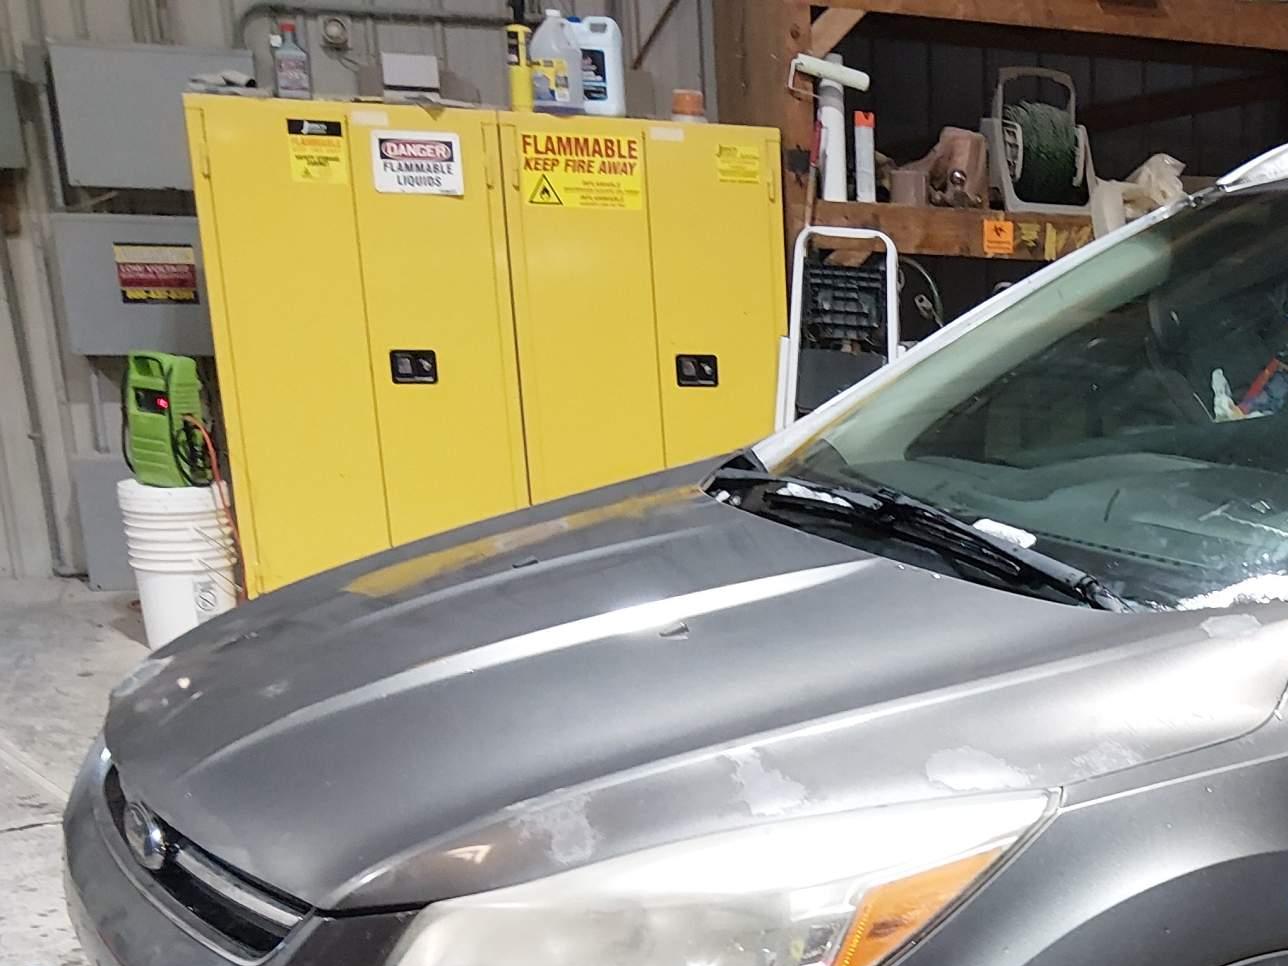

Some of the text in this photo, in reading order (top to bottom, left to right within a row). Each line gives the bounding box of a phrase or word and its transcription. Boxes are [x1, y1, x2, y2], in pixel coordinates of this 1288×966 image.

[385, 143, 447, 159] DANGER
[521, 134, 638, 159] FLAMMABLE
[383, 161, 454, 175] FLAMMABLE
[523, 156, 637, 176] KEEP FIRE AWAY
[396, 175, 442, 188] LIQUIDS
